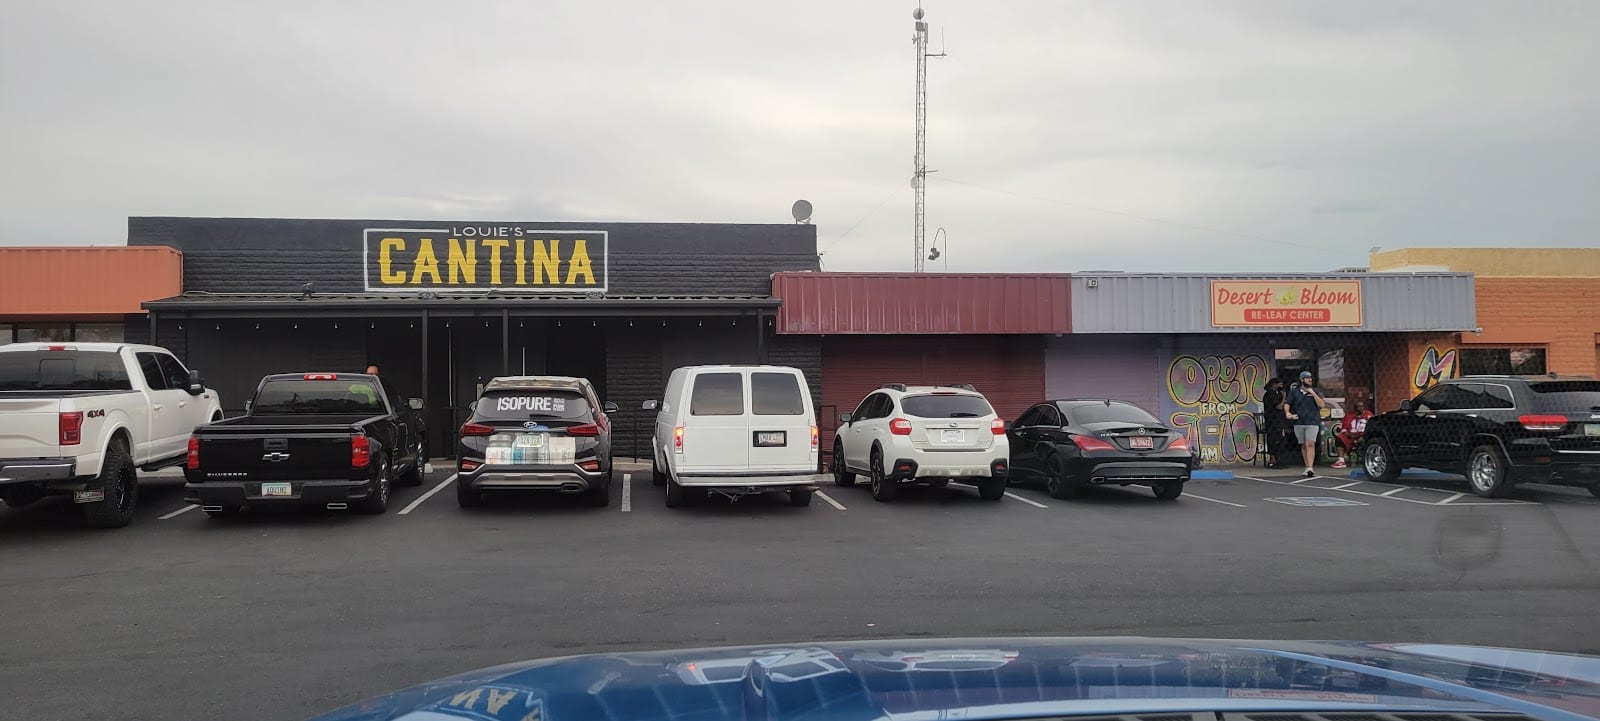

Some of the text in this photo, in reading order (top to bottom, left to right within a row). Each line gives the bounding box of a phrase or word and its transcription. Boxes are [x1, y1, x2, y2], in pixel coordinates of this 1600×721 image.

[453, 226, 524, 237] LOUIE'S
[377, 237, 597, 285] CANTINA
[1218, 284, 1357, 305] Desert Bloom
[1251, 310, 1324, 320] RE-LEAF CENTER
[497, 397, 552, 411] ISOPURE
[1202, 402, 1237, 415] FROM
[1201, 447, 1218, 461] AM
